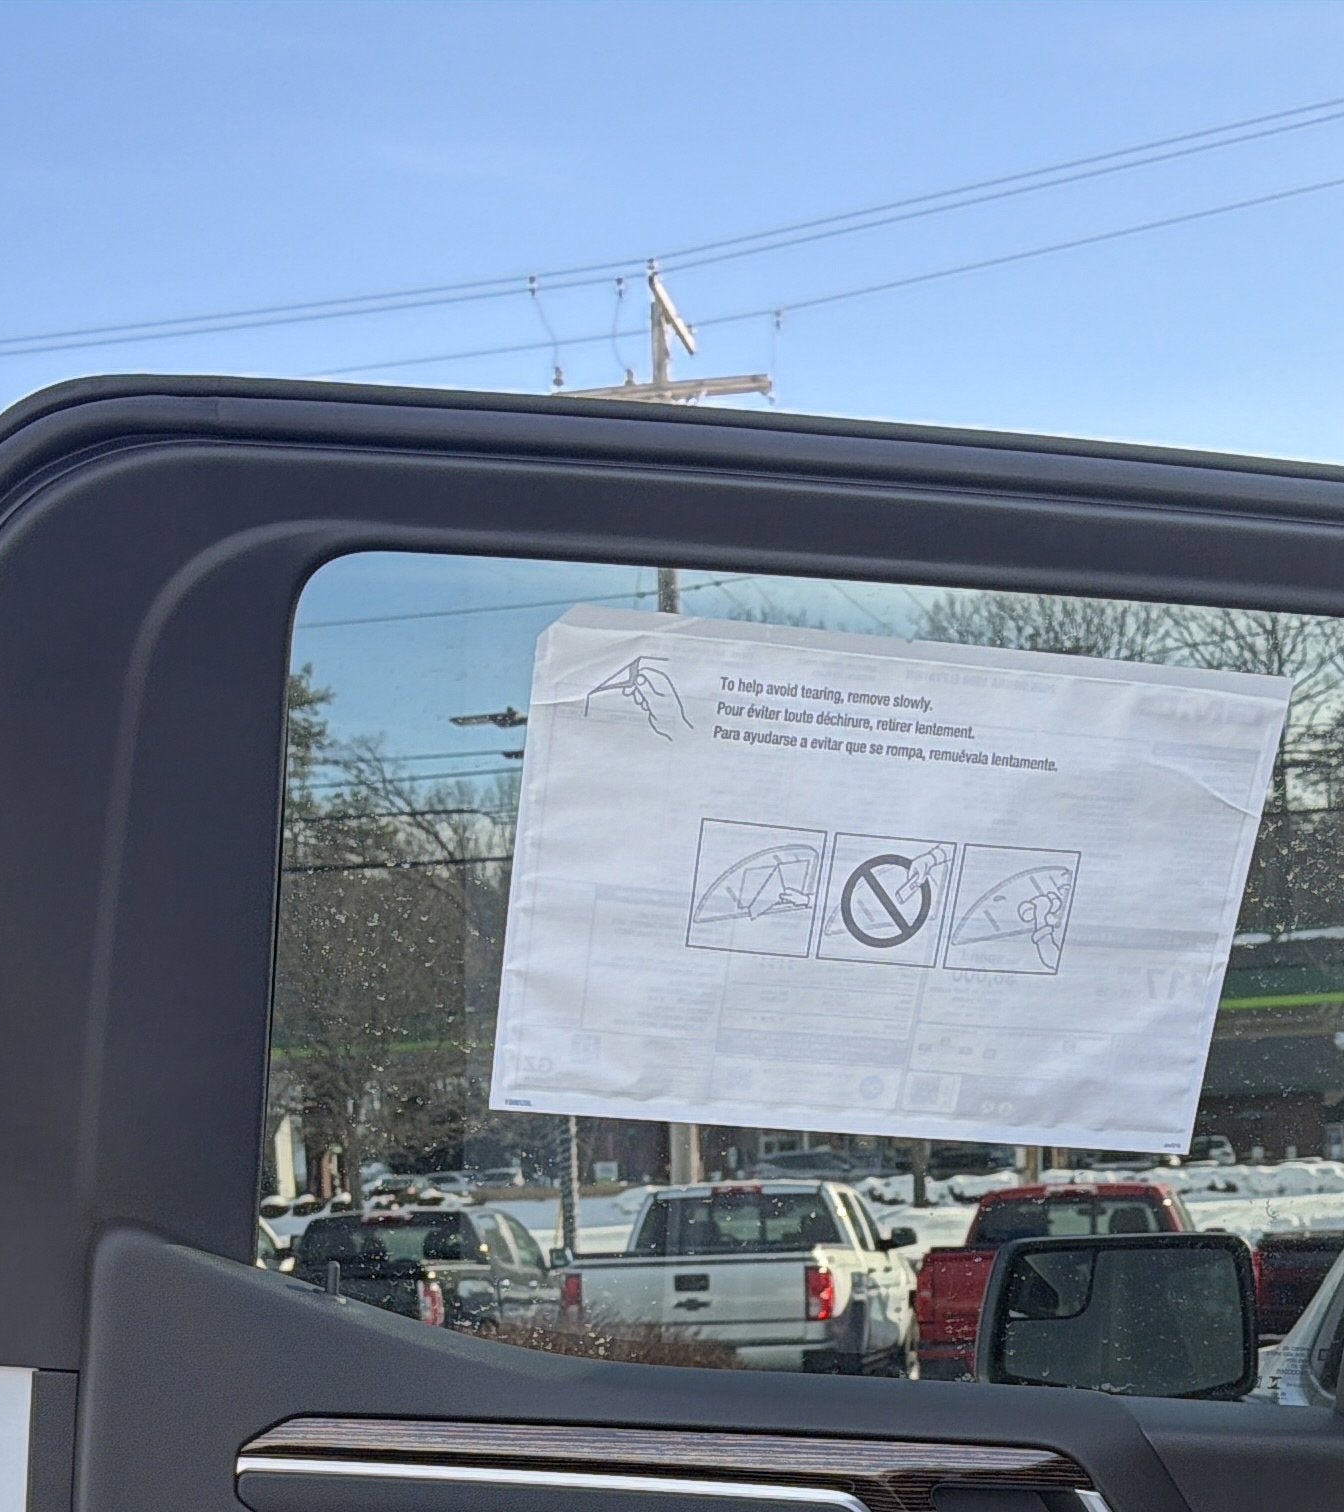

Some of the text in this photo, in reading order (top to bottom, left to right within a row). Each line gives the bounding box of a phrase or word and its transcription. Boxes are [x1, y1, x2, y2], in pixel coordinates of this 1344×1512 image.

[720, 676, 933, 713] To help avoid tearing, remove slowly.
[717, 701, 975, 740] Pour éviter toute déchirure, retirer lentement.
[713, 725, 1058, 772] Para ayudarse a evitar que se rompa, remuévala lentamente.
